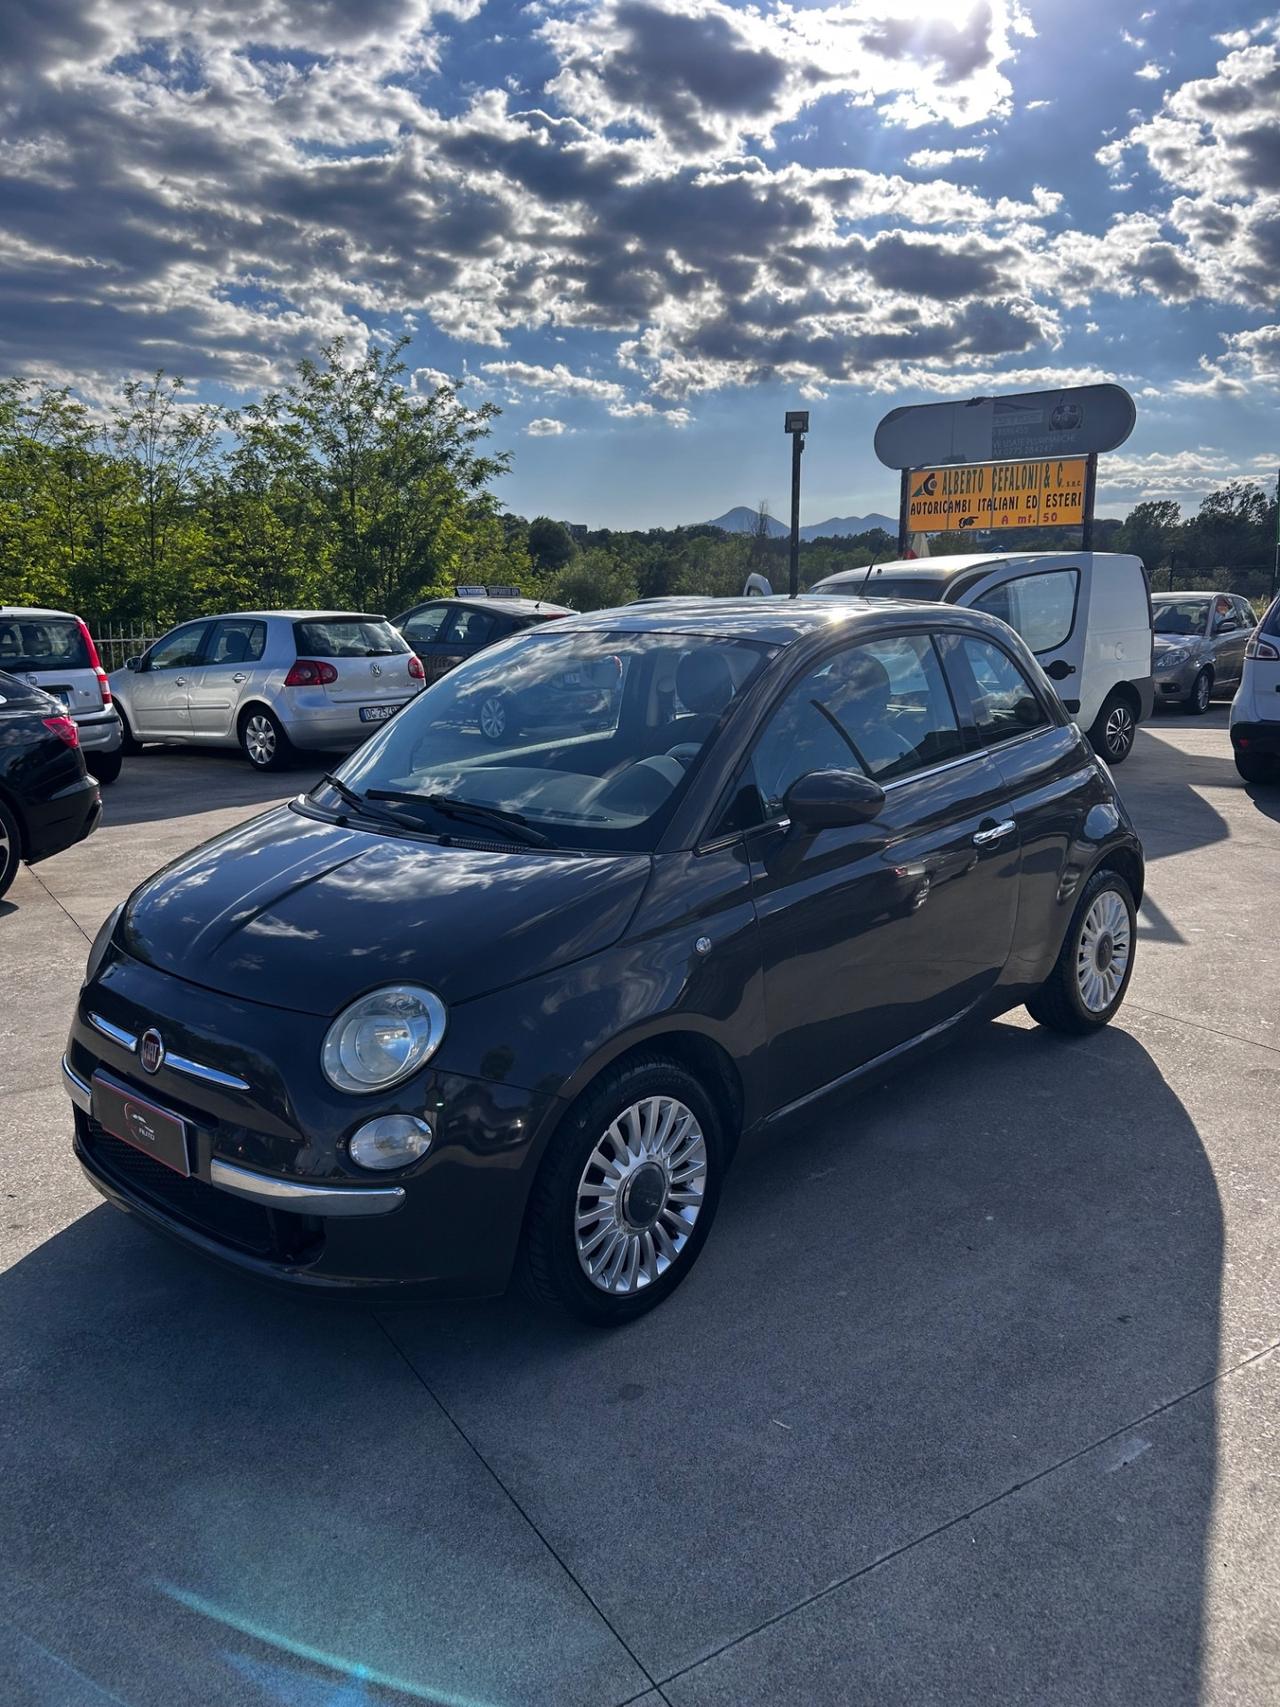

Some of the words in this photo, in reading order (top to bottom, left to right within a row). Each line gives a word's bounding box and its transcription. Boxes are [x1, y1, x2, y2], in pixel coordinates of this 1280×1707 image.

[942, 468, 984, 495] ALBERTO
[992, 464, 1038, 492] CEFALONI
[1043, 463, 1051, 489] &
[910, 499, 972, 516] AUTORICAMBI
[977, 495, 1019, 512] ITALIANI
[1025, 494, 1038, 510] ED
[1045, 491, 1082, 508] ESTERI
[1001, 515, 1009, 525] A
[1043, 512, 1058, 522] 50
[143, 1040, 159, 1063] FIAT
